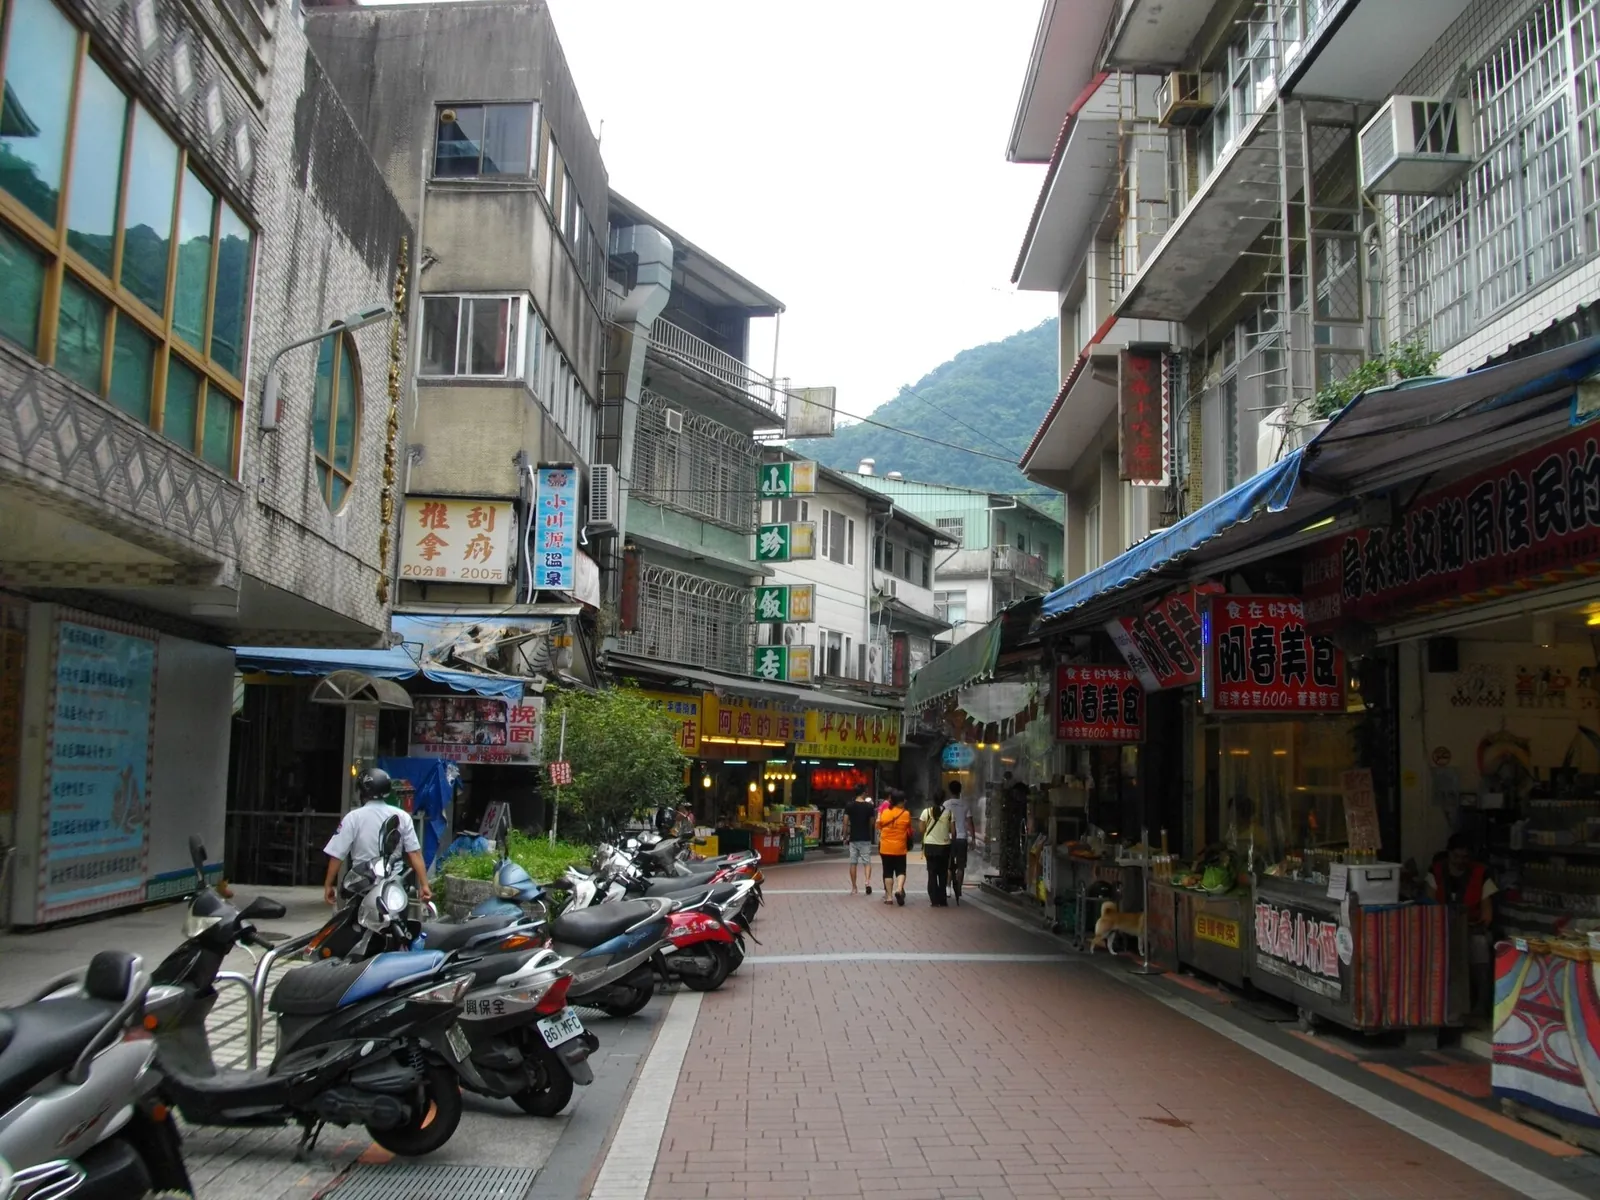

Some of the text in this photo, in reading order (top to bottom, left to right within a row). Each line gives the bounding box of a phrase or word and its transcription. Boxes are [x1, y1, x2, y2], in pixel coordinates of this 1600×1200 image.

[416, 501, 450, 561] 推拿
[463, 505, 496, 565] 刮痧
[460, 567, 503, 579] 200元
[1225, 601, 1305, 620] 食在好味
[1060, 683, 1141, 727] 阿春美食
[543, 1016, 581, 1043] 861-MFC
